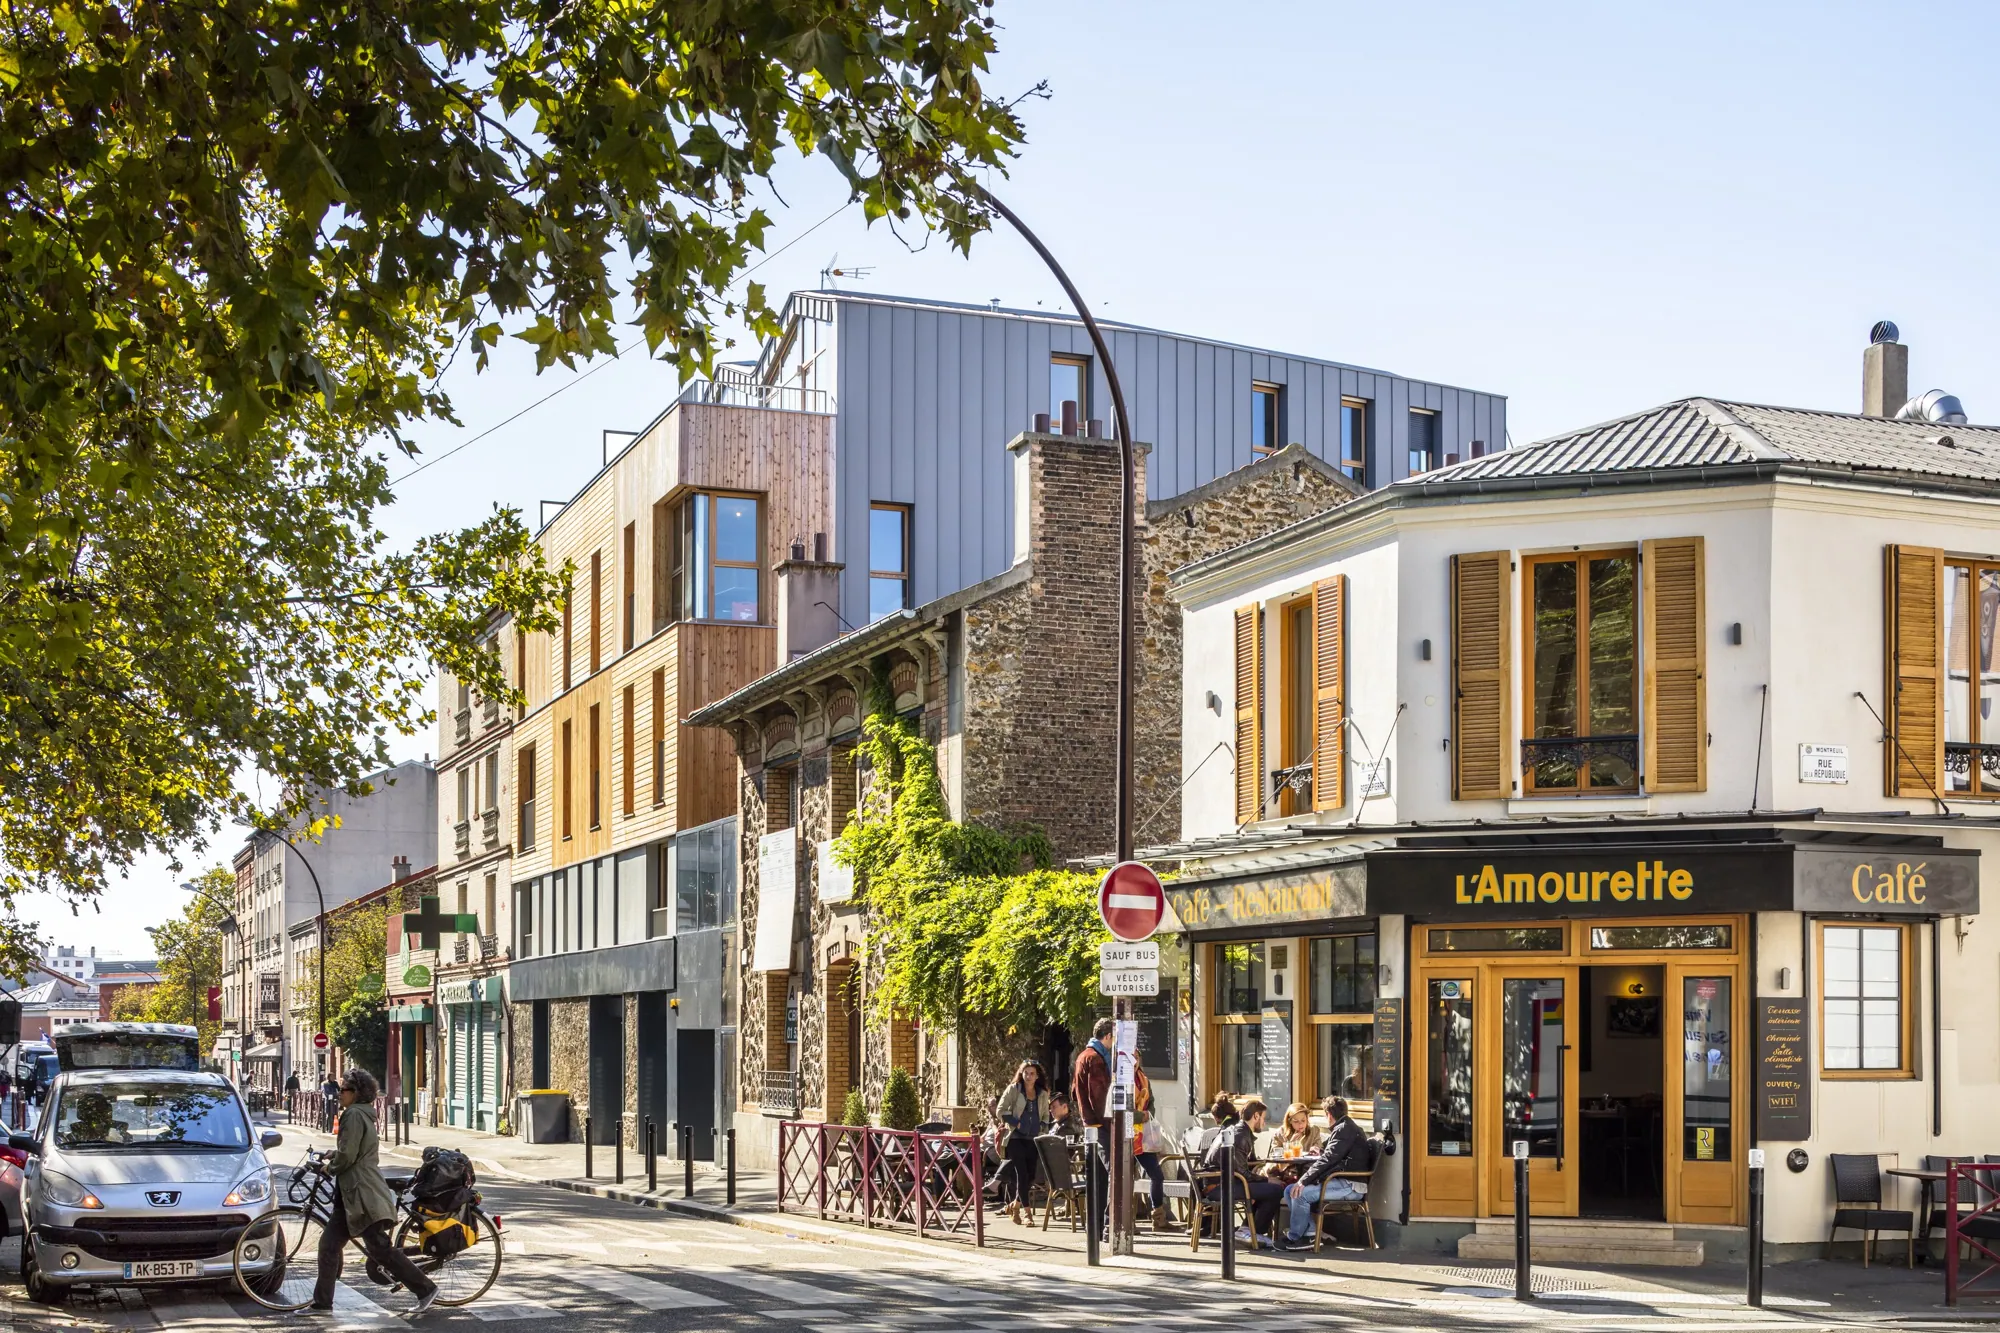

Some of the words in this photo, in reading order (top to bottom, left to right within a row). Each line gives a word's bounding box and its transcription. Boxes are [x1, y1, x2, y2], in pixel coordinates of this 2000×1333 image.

[1817, 759, 1833, 768] RUE
[1814, 769, 1846, 779] RÉPUBLIQUE
[1456, 860, 1694, 904] L'Amourette
[1852, 862, 1927, 905] Café
[1172, 888, 1210, 925] Café
[1232, 875, 1333, 920] Restaurant
[1105, 951, 1131, 960] SAUF
[1136, 951, 1156, 960] BUS
[1116, 973, 1145, 982] VÉLOS
[1105, 983, 1155, 992] AUTORISÉS
[1767, 1005, 1801, 1014] Terrasse
[1766, 1034, 1801, 1042] Cheminée
[1770, 1097, 1794, 1105] WIFI
[135, 1262, 194, 1277] AK-853-TP
